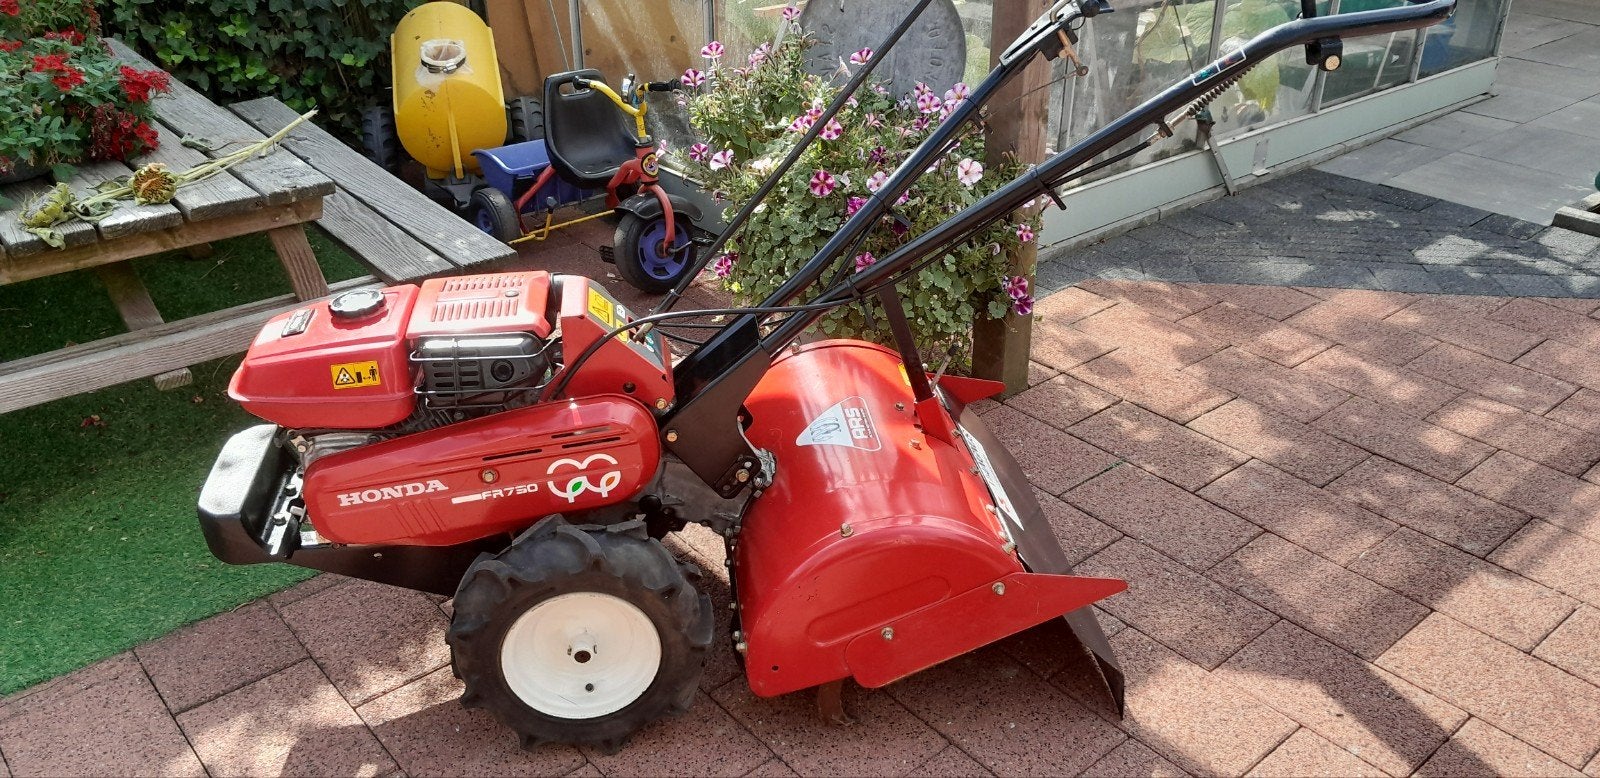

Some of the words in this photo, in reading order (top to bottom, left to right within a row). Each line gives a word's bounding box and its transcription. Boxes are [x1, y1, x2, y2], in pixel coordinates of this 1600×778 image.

[844, 408, 869, 439] ARS
[337, 479, 449, 507] HONDA
[481, 483, 538, 501] FR750
